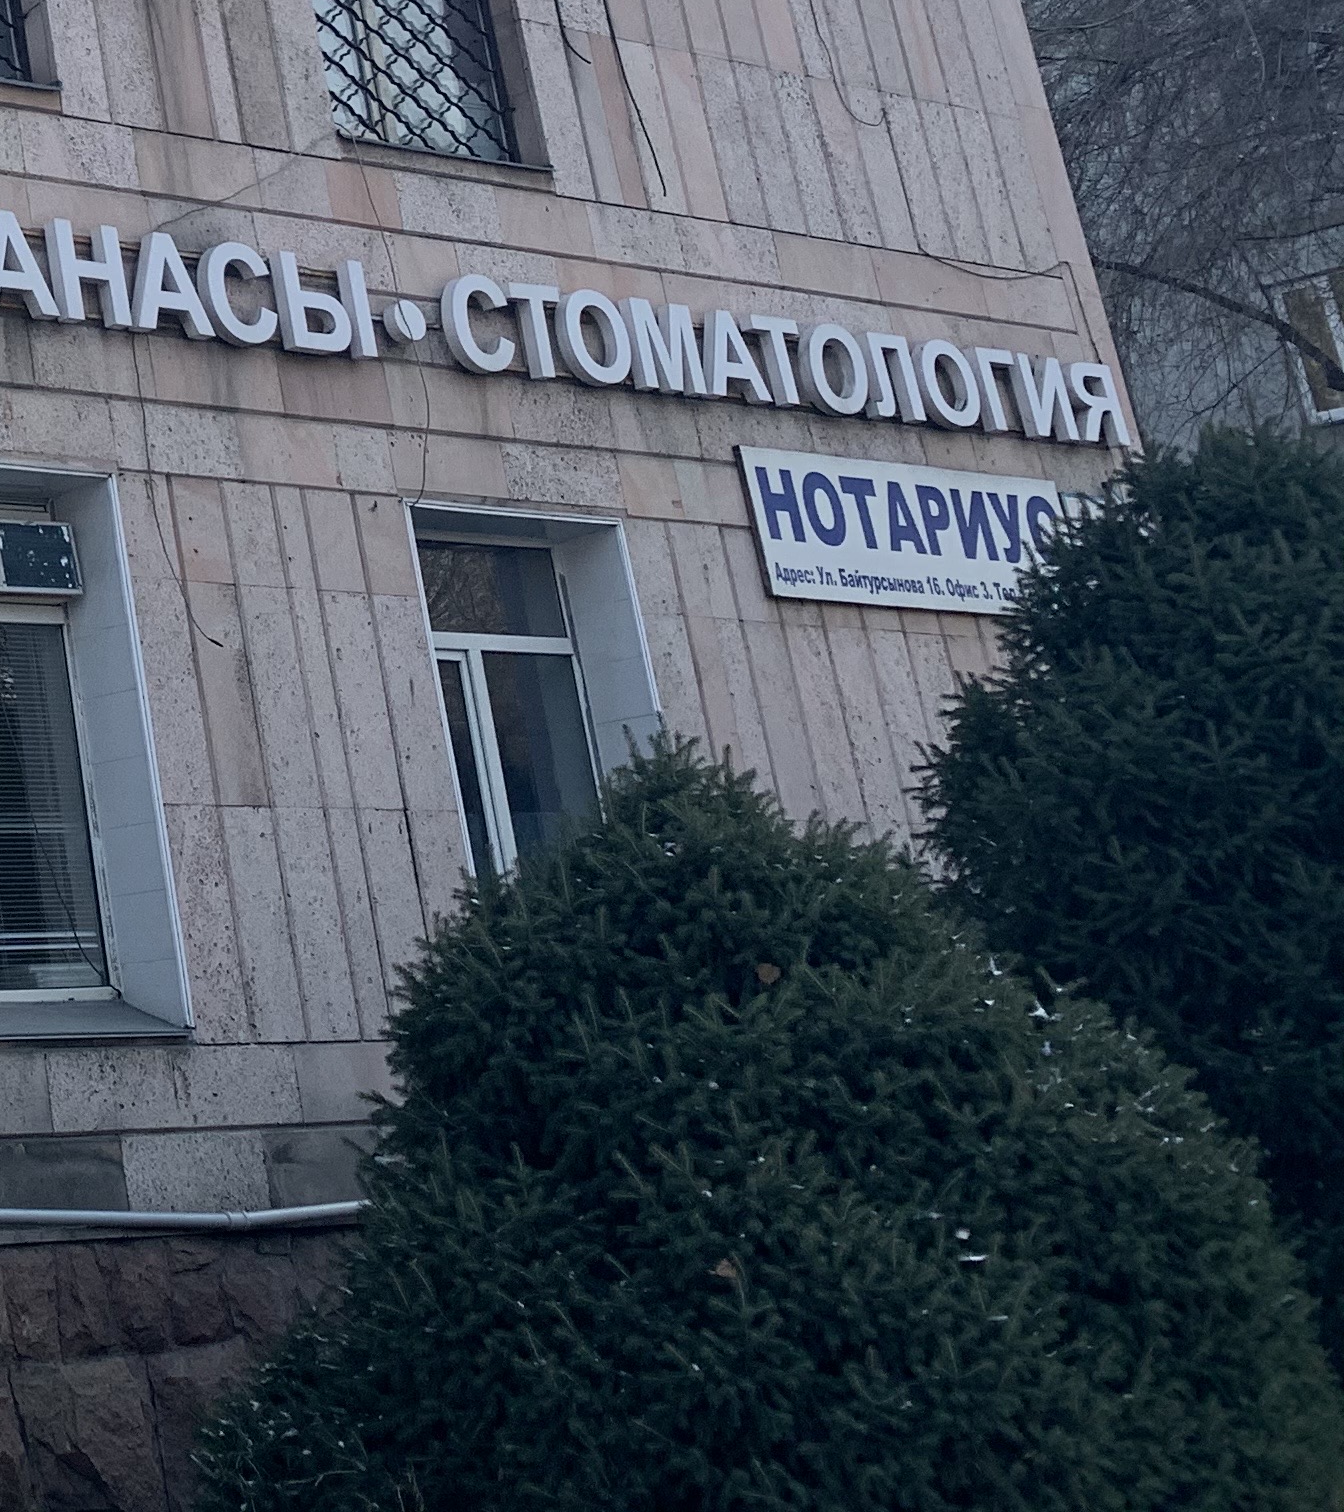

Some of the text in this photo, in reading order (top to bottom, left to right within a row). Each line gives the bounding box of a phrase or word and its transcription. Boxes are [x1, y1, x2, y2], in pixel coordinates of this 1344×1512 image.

[441, 274, 1130, 447] СТОМАТОЛОГИЯ
[926, 576, 945, 597] 16.
[945, 578, 980, 602] Офис
[982, 582, 994, 600] 3.
